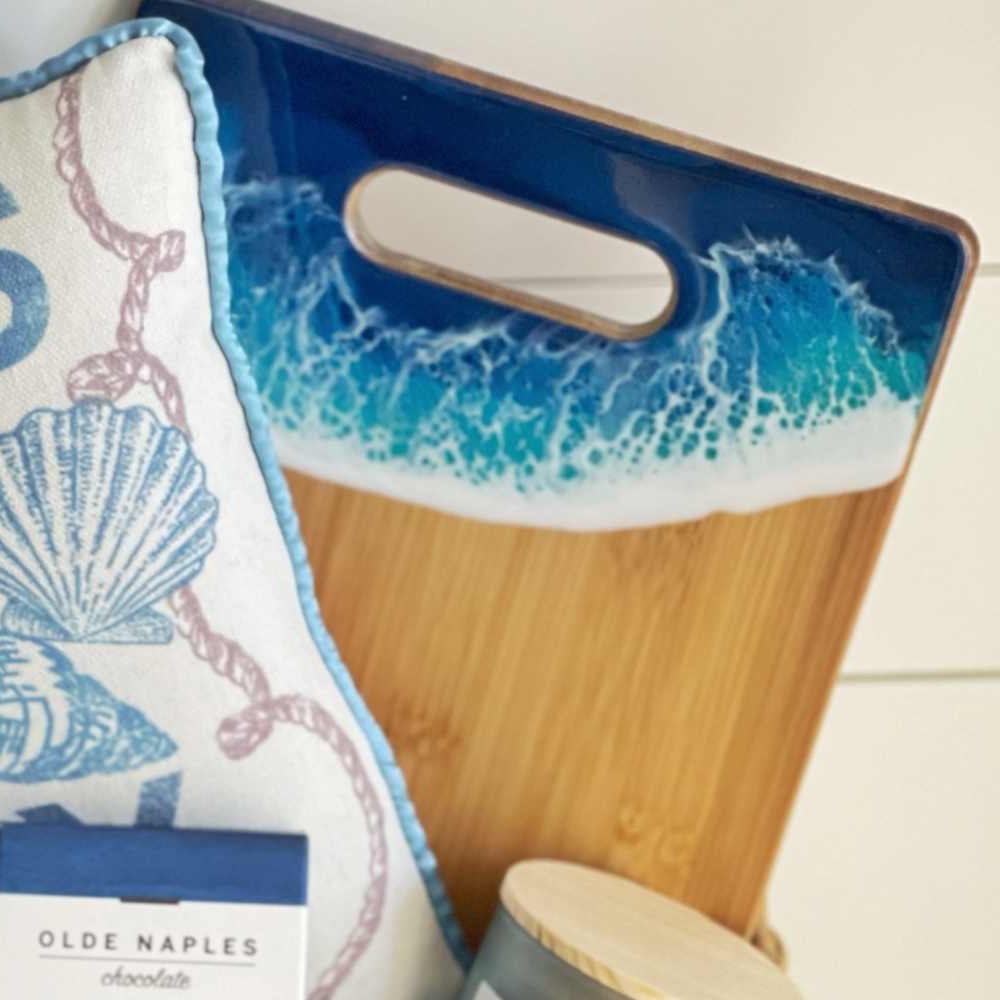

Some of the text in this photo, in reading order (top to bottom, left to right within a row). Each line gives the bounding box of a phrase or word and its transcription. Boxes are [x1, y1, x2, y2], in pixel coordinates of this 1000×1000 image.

[38, 930, 258, 956] OLDE NAPLES
[100, 965, 191, 990] chocolate
